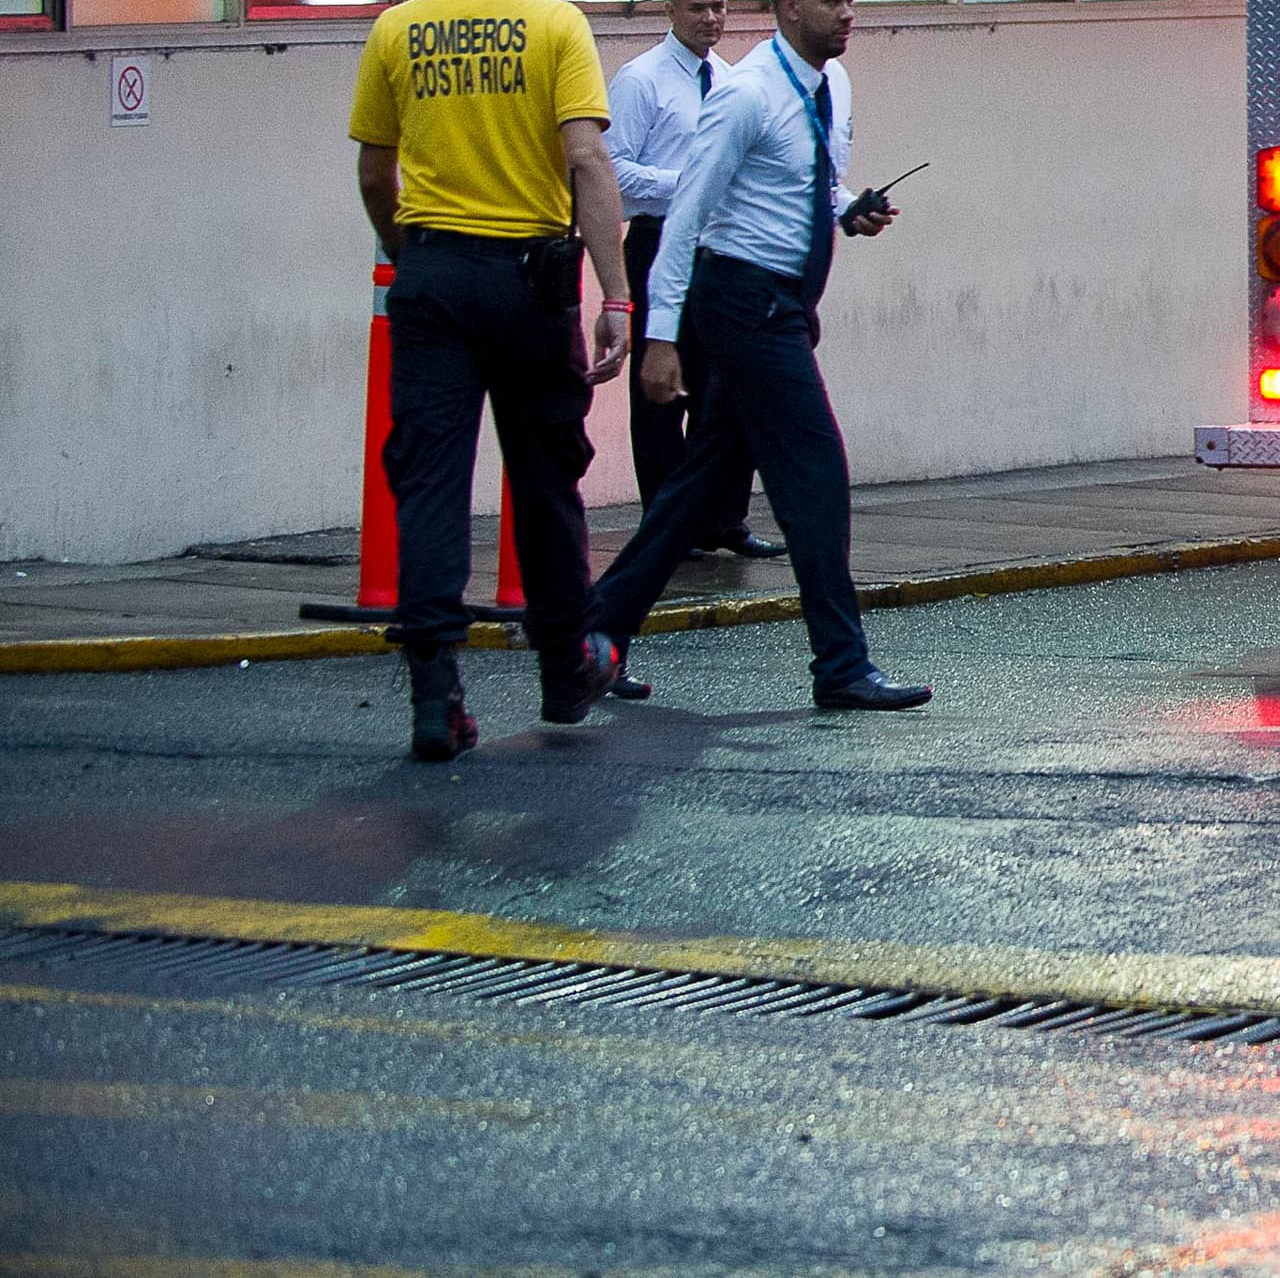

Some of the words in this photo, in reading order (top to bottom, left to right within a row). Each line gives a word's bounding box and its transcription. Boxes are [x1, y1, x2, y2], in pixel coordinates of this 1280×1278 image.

[409, 18, 526, 60] BOMBEROS
[412, 58, 474, 99] COSTA
[480, 56, 526, 94] RICA
